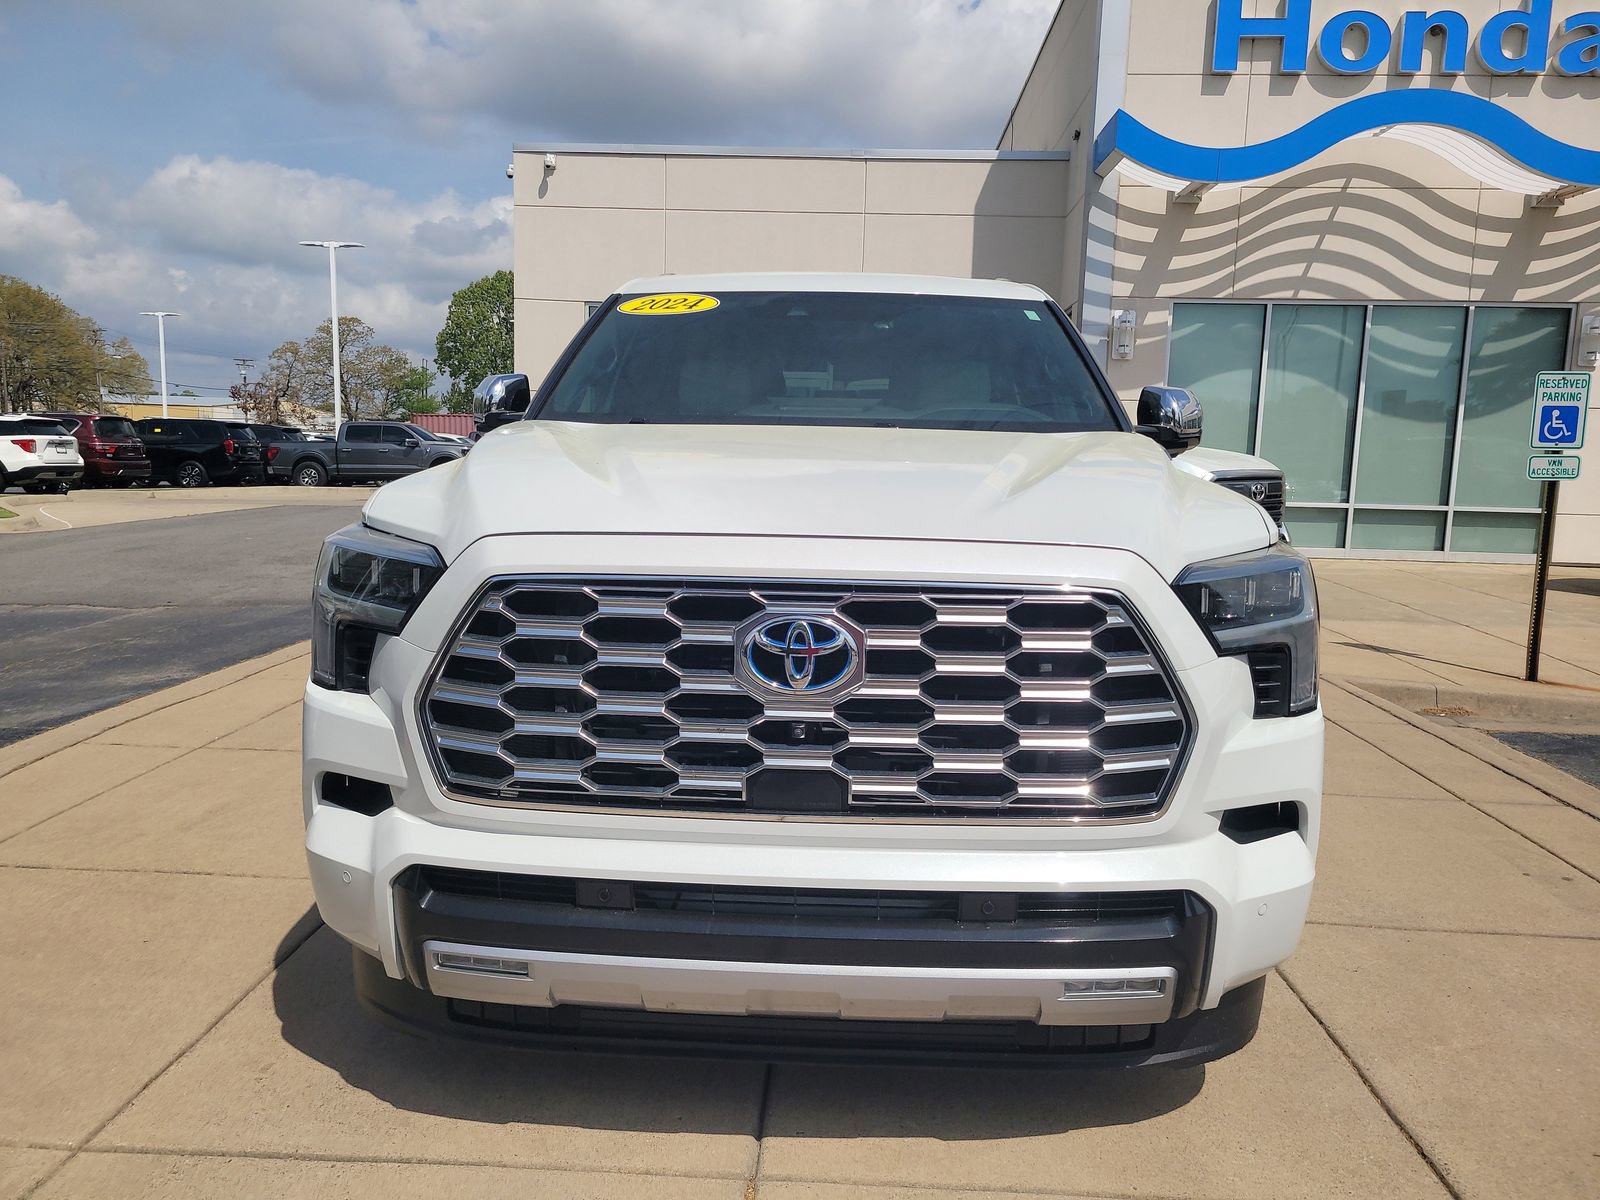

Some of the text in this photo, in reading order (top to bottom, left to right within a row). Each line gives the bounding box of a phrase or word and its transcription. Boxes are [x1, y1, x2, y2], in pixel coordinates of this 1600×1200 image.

[1211, 0, 1600, 75] Honda
[631, 298, 706, 311] 2024
[1540, 379, 1588, 388] RESERVED
[1542, 392, 1582, 401] PARKING
[1547, 459, 1563, 467] VAN
[1531, 468, 1577, 476] ACCESSIBLE
